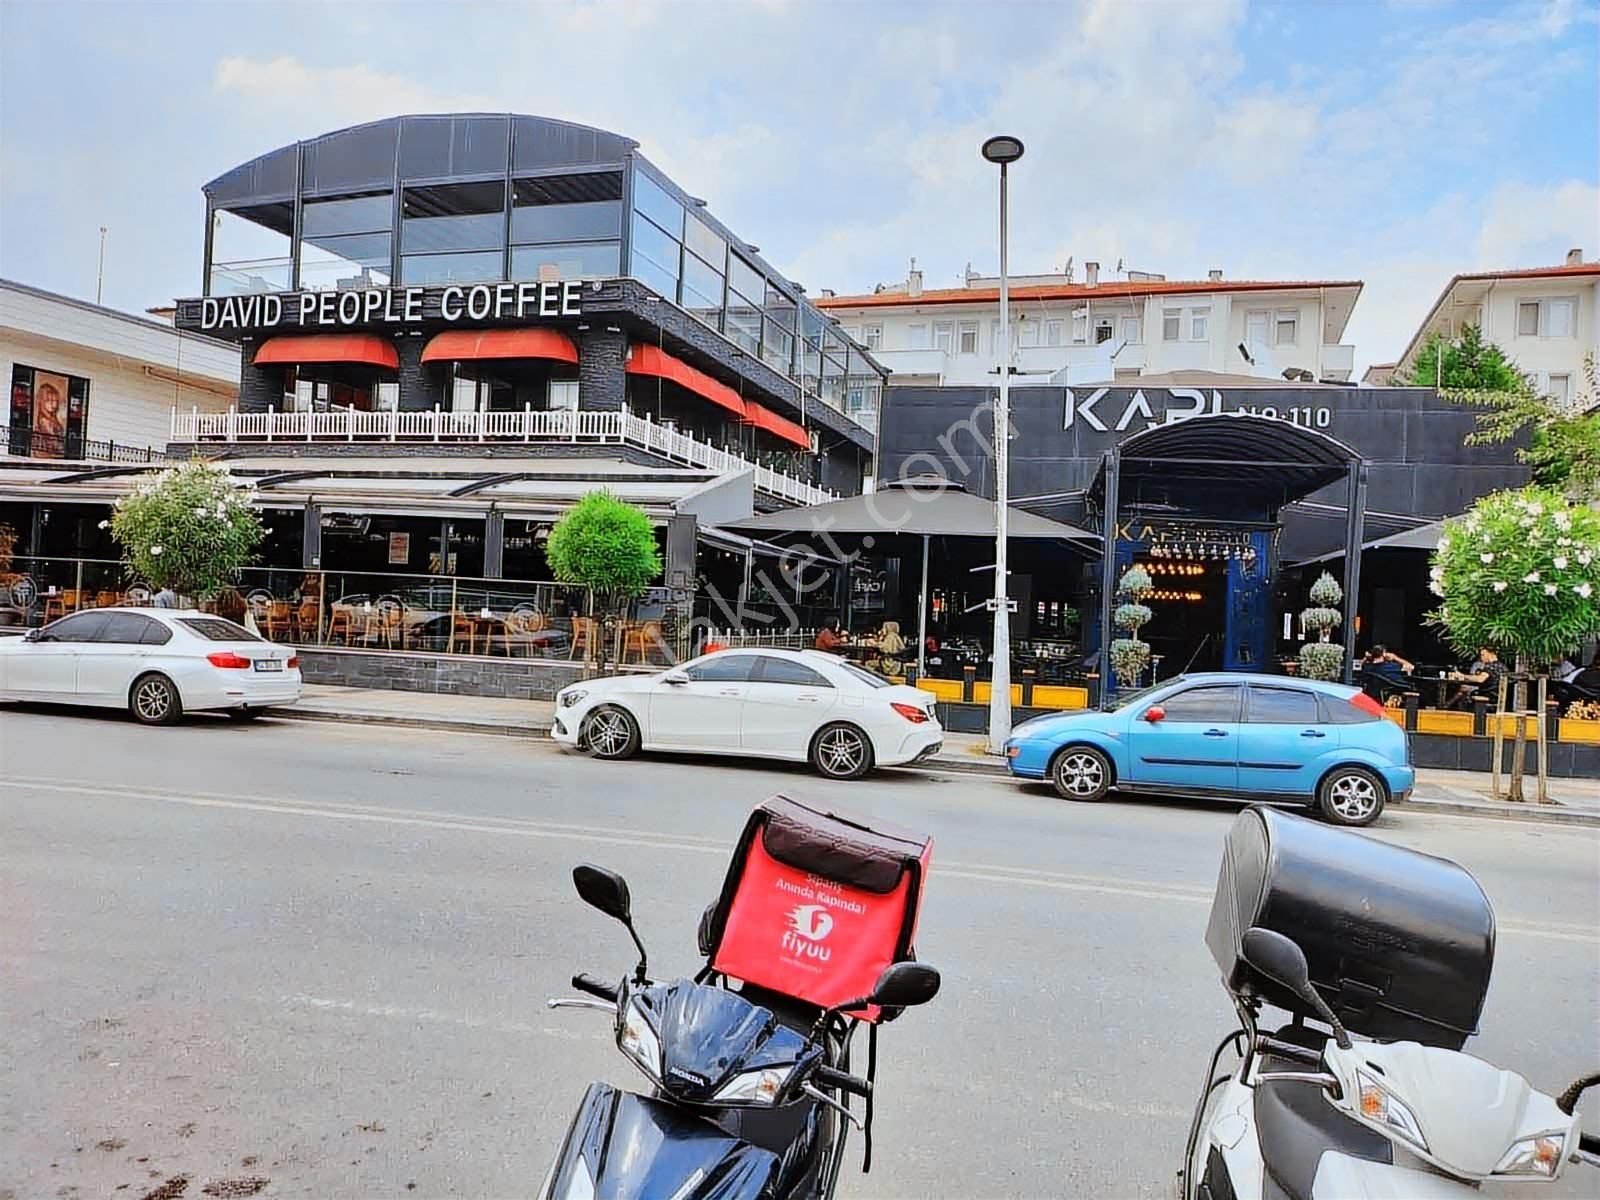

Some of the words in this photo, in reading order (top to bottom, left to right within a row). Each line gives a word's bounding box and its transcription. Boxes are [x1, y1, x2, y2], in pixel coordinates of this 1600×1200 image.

[201, 295, 281, 329] DAVID
[300, 287, 424, 326] PEOPLE
[441, 281, 583, 321] COFFEE
[782, 931, 832, 961] fiyuu
